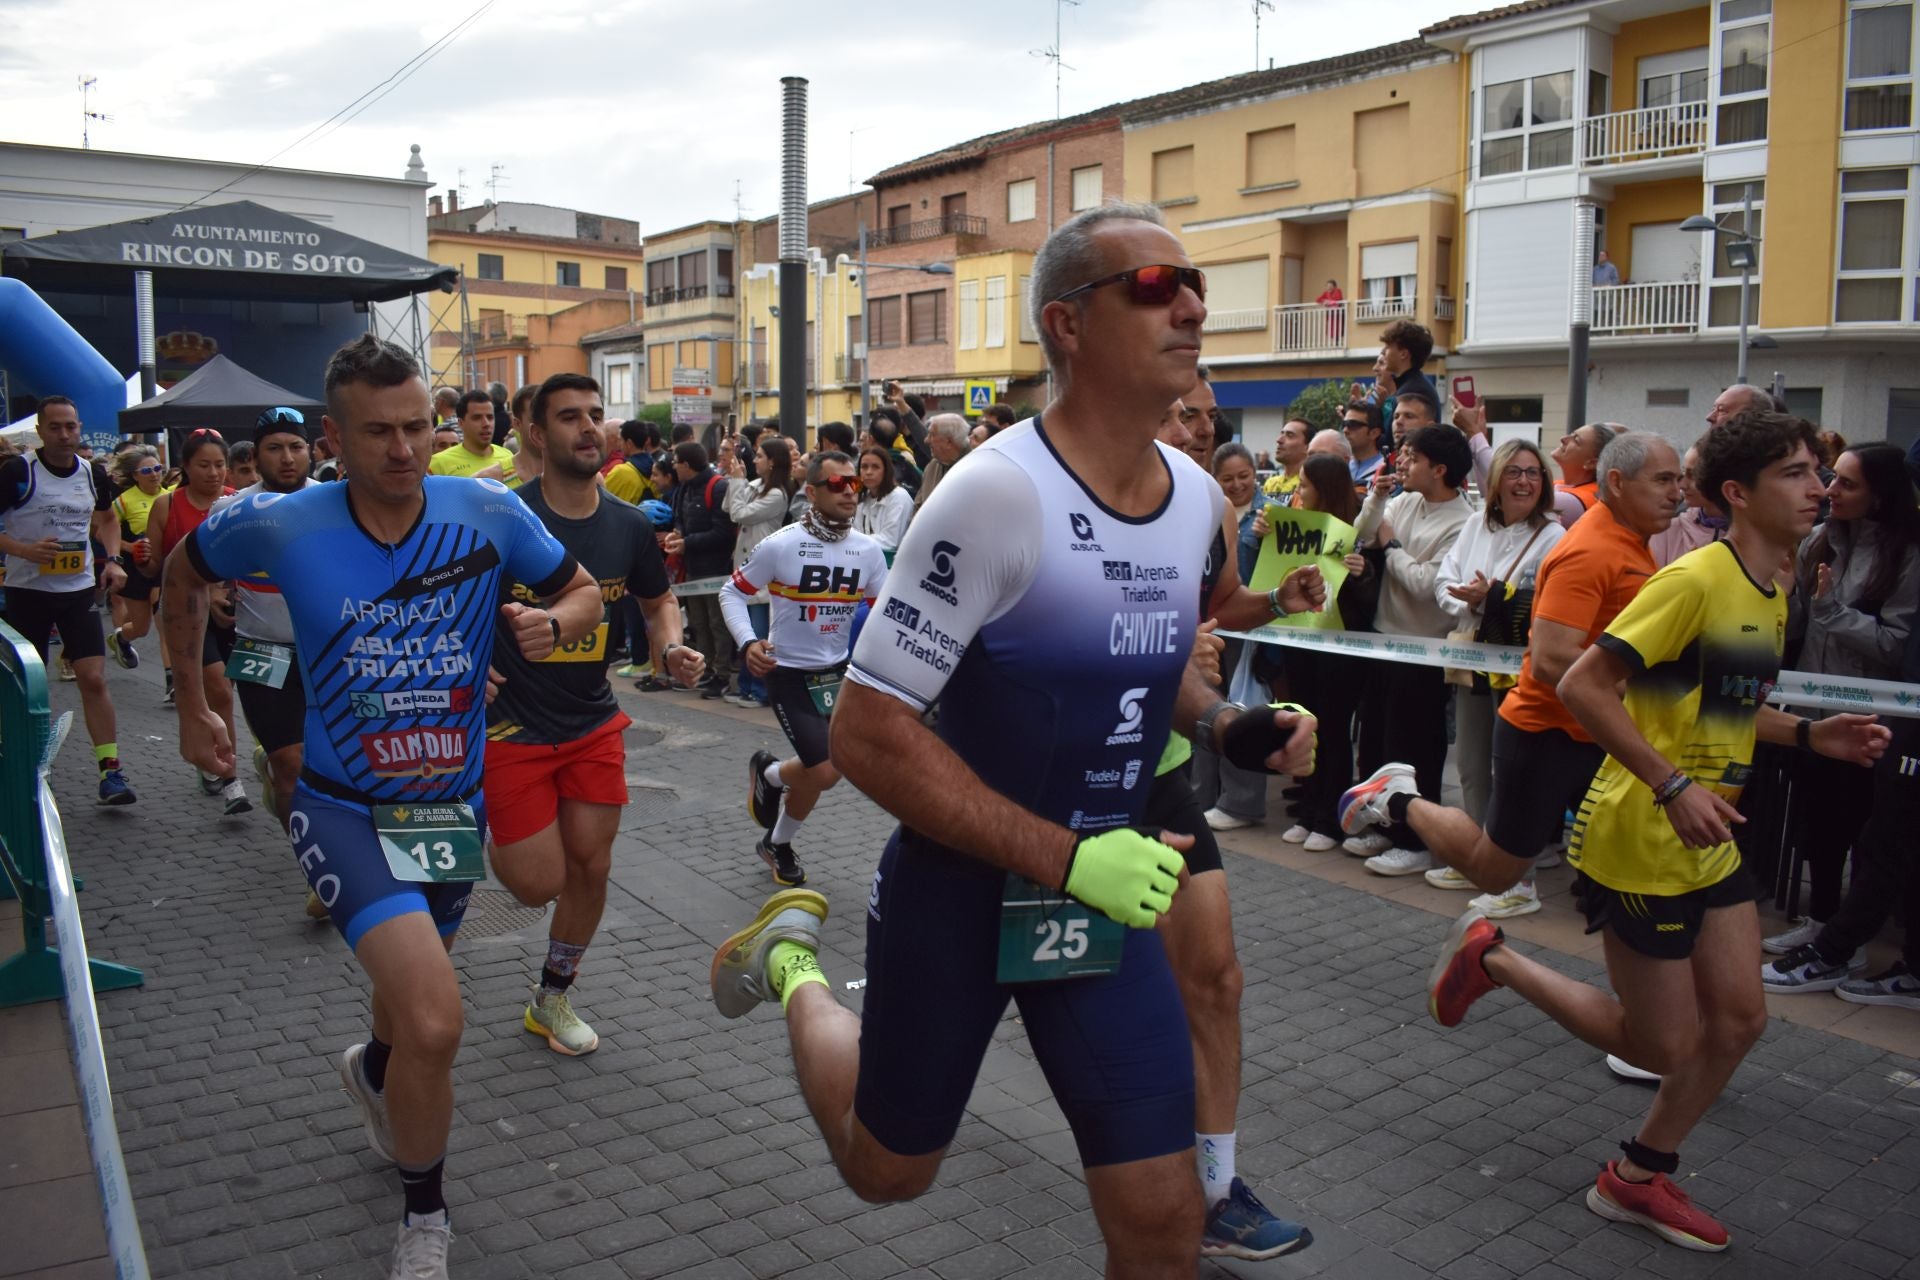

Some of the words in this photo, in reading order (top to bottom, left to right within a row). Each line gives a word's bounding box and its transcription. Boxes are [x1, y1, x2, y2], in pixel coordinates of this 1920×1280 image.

[171, 223, 321, 247] AYUNTAMIENTO
[121, 242, 233, 267] RINCON
[243, 250, 282, 270] DE
[291, 253, 366, 274] SOTO
[422, 565, 464, 586] MAGLIA
[798, 565, 861, 595] BH
[1104, 562, 1132, 580] sdr
[1134, 564, 1180, 582] Arenas
[919, 578, 959, 607] SONOCO
[1121, 586, 1168, 603] Triatlón
[340, 593, 456, 627] ARRIAZU
[884, 598, 919, 631] sdr
[1110, 610, 1179, 656] CHIVITE
[895, 629, 952, 676] Triatlón
[240, 658, 272, 677] 27
[342, 651, 473, 678] TRIATLON
[823, 691, 834, 707] 8
[1822, 684, 1843, 692] CAJA
[1843, 686, 1871, 696] RURAL
[1822, 690, 1834, 699] DE
[1835, 692, 1874, 703] NAVARRA
[391, 697, 402, 706] A
[400, 708, 442, 717] BIKES
[373, 731, 463, 765] SANDUA
[1105, 732, 1143, 746] SONOCO
[1085, 769, 1121, 782] Tudela
[413, 808, 432, 816] CAJA
[426, 814, 460, 822] NAVARRA
[289, 810, 341, 908] GEO
[411, 841, 457, 870] 13
[1032, 918, 1090, 962] 25
